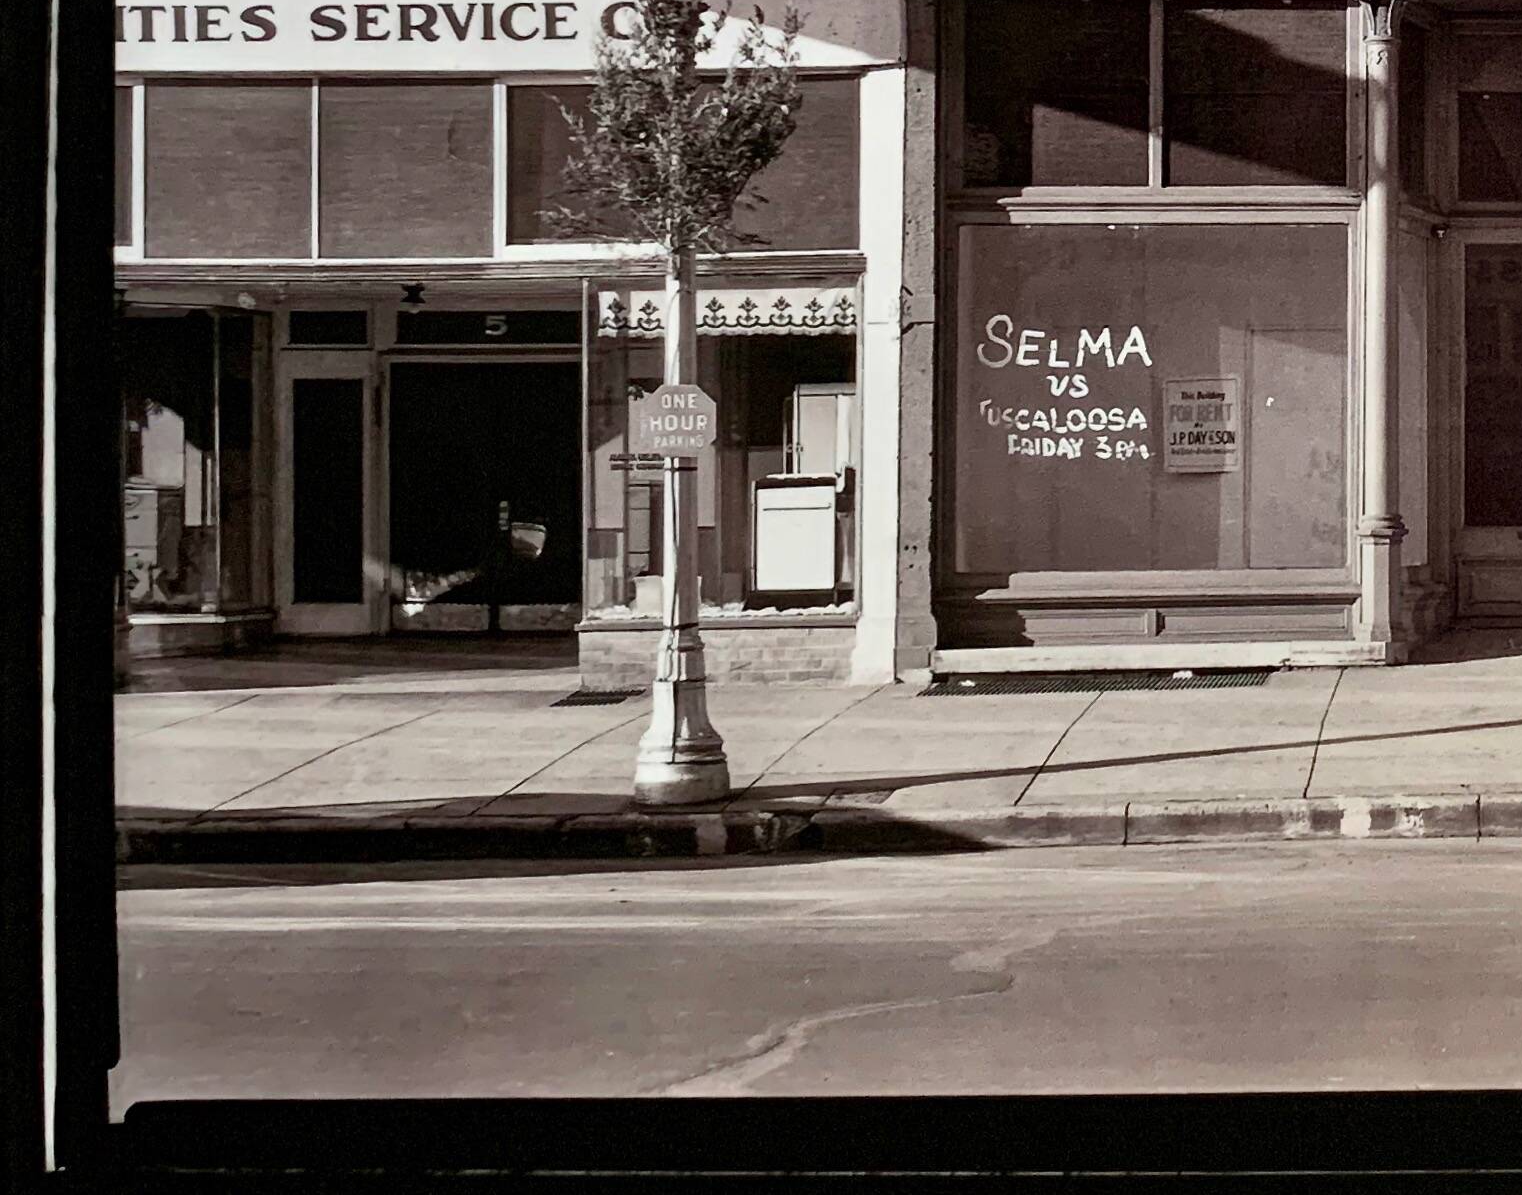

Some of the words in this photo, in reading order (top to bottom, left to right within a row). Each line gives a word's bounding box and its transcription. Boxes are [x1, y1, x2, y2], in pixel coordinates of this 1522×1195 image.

[311, 1, 579, 42] SERVICE
[485, 315, 508, 336] 5
[977, 314, 1153, 368] SELMA
[661, 393, 698, 409] ONE
[650, 414, 708, 432] HOUR
[979, 399, 1148, 433] TUSCALOOSA
[654, 434, 704, 449] PARKING
[1007, 434, 1084, 459] FRIDAY
[1095, 435, 1113, 459] 3
[1215, 430, 1236, 445] SON
